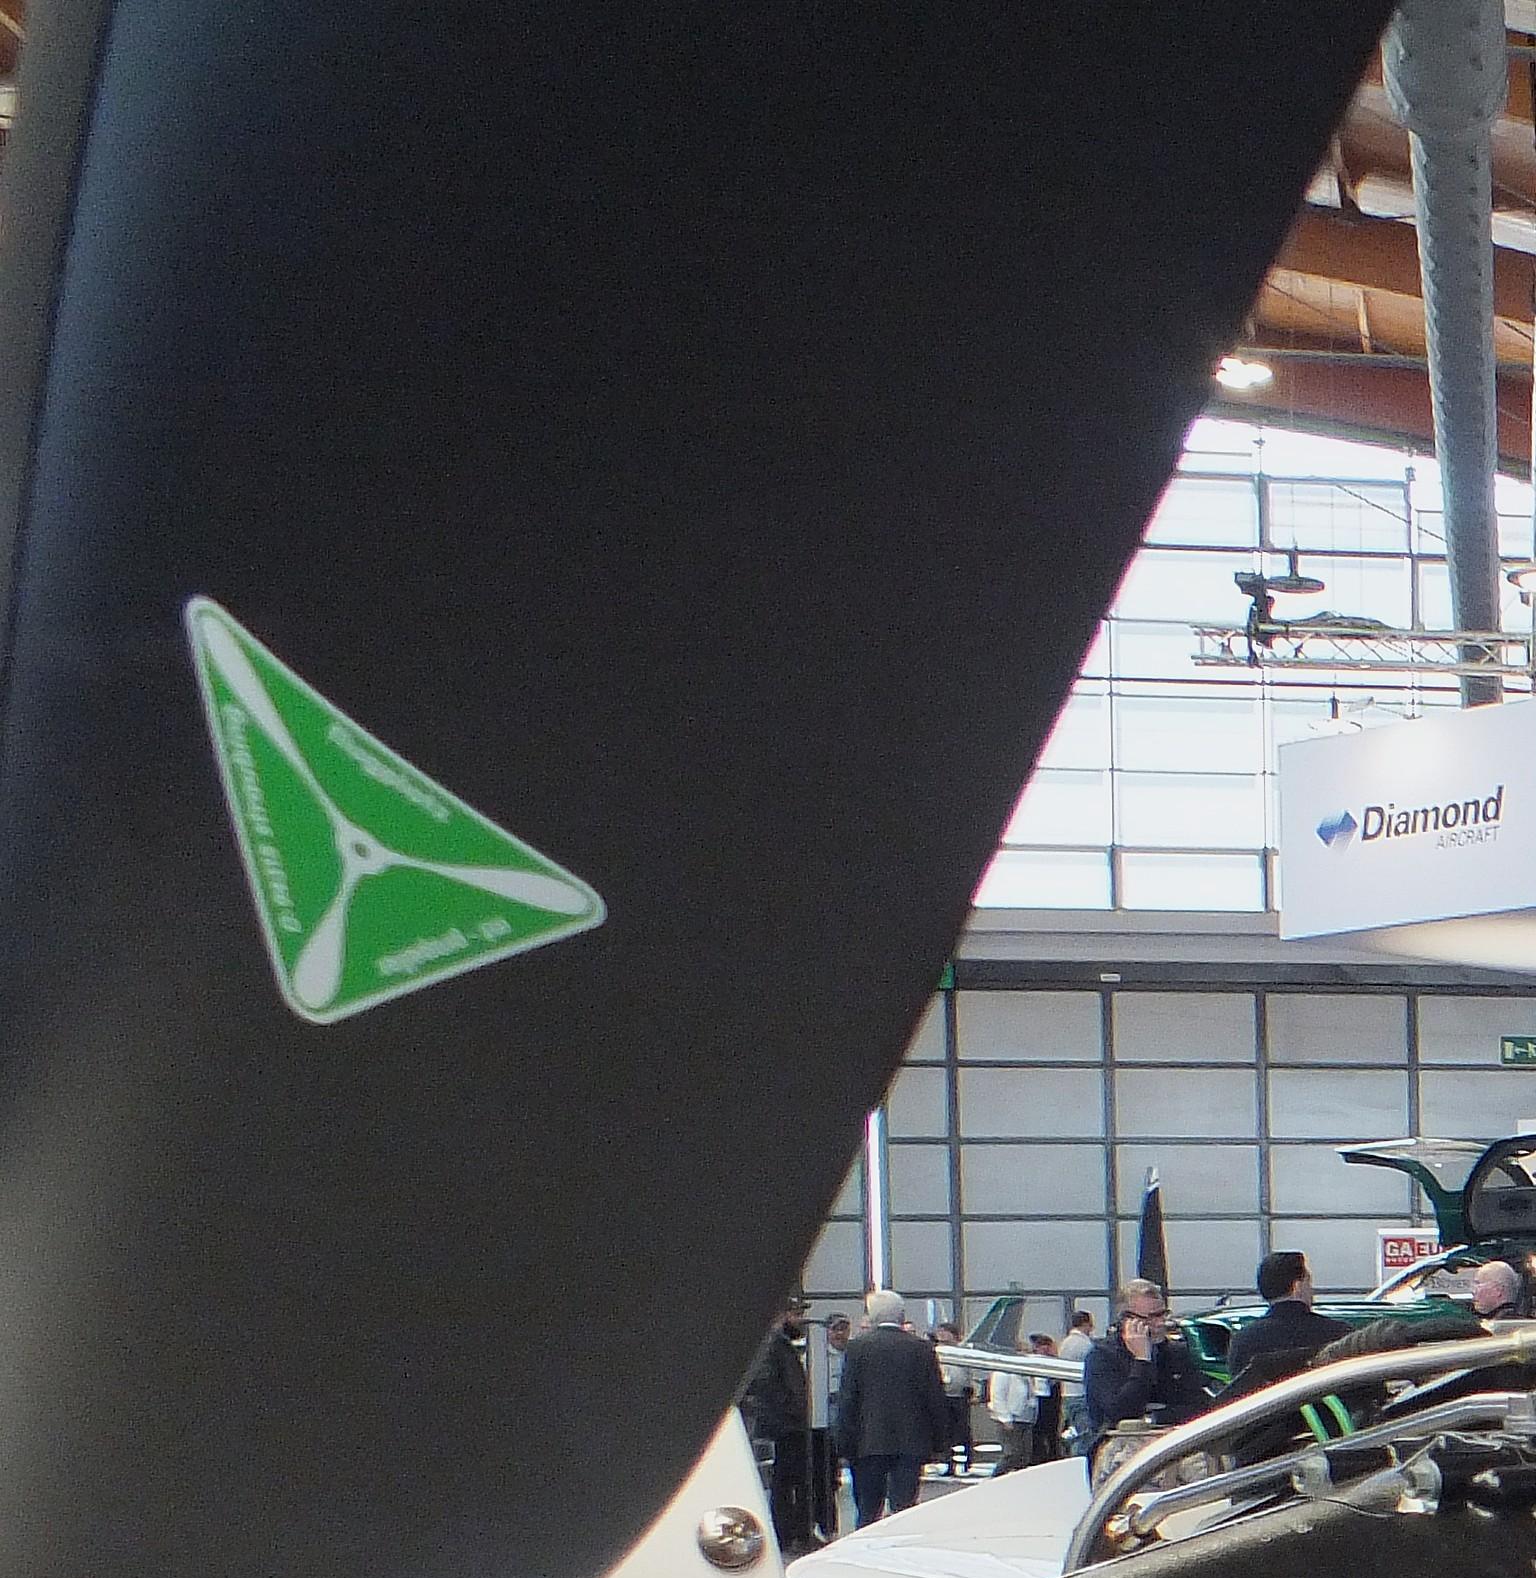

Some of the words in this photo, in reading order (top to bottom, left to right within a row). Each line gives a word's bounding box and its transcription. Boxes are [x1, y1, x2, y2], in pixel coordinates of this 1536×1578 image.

[1360, 784, 1504, 842] Diamond
[1435, 824, 1503, 850] AIRCRAFT
[1385, 1240, 1414, 1257] GA
